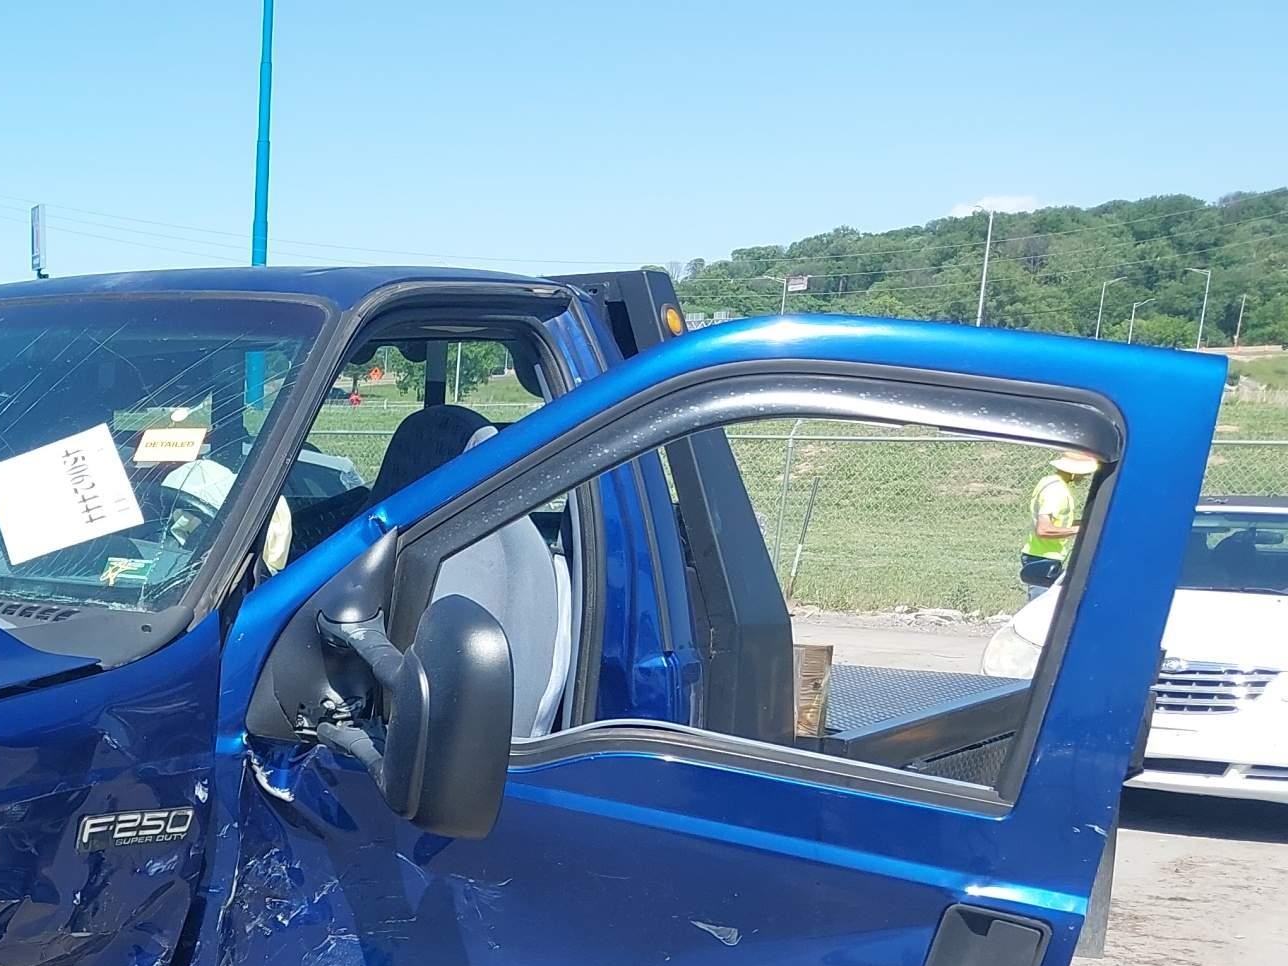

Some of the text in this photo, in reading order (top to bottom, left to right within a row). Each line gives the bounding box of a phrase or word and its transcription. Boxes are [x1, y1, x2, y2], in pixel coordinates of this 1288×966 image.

[145, 440, 195, 448] DETAILED
[116, 833, 187, 846] SUPER DUTY
